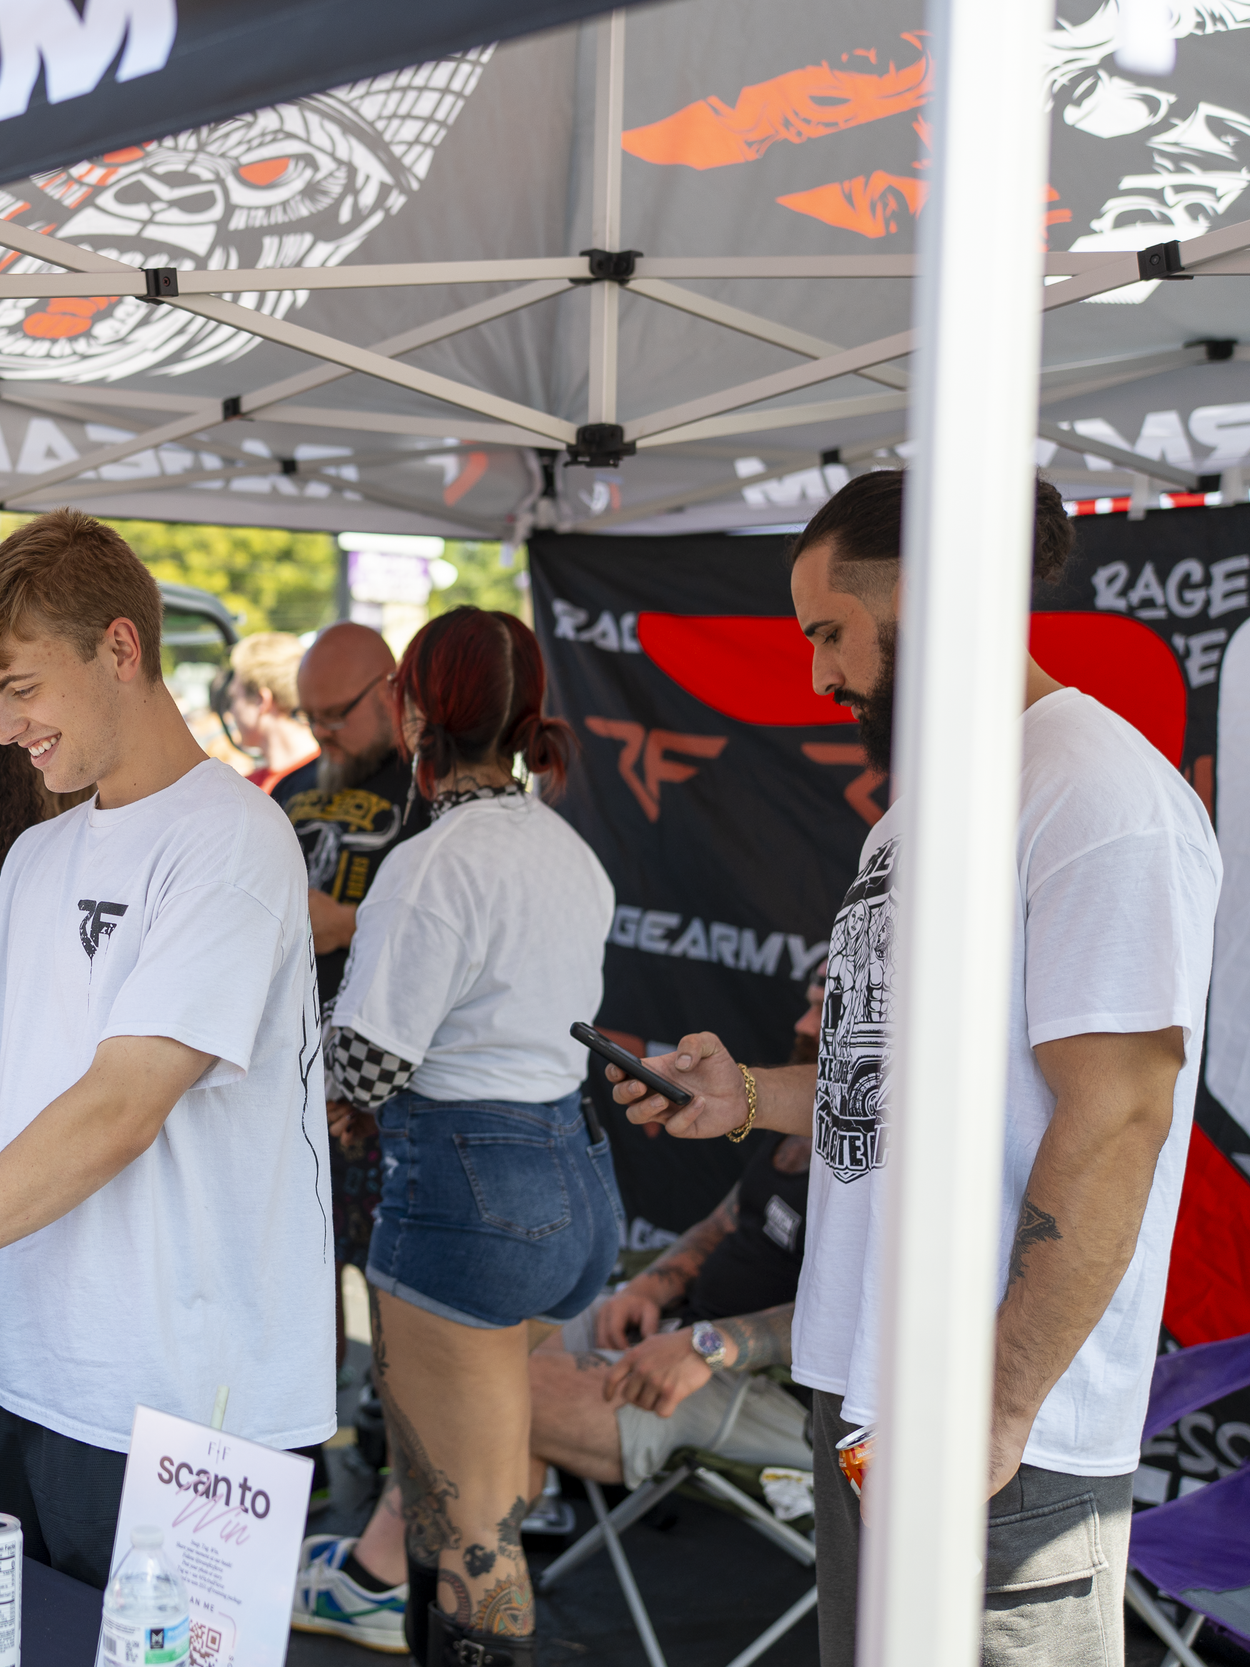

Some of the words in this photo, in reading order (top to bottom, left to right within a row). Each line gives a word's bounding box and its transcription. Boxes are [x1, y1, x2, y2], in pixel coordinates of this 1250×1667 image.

[1091, 554, 1250, 618] RAGE
[157, 1455, 232, 1507] scan
[238, 1476, 271, 1519] to
[190, 1596, 200, 1606] AN
[203, 1601, 214, 1612] ME
